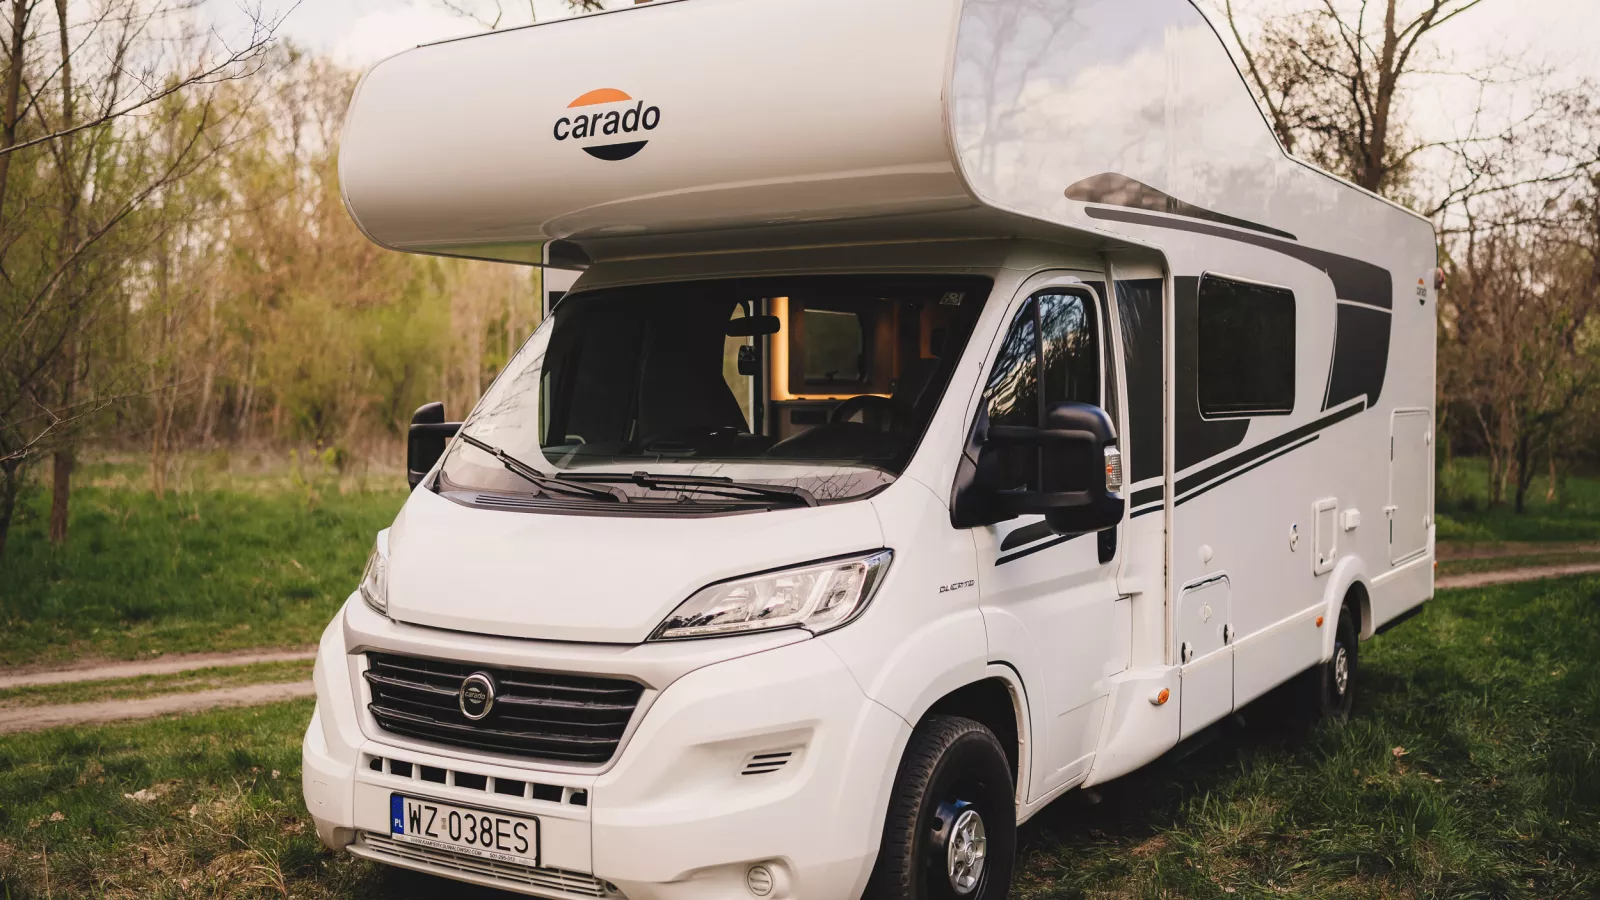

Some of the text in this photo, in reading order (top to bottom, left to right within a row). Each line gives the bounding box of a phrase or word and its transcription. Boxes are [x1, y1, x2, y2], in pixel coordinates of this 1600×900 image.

[553, 100, 660, 141] carado
[465, 691, 486, 700] carado
[394, 818, 402, 828] PL
[408, 802, 529, 854] WZ 038ES
